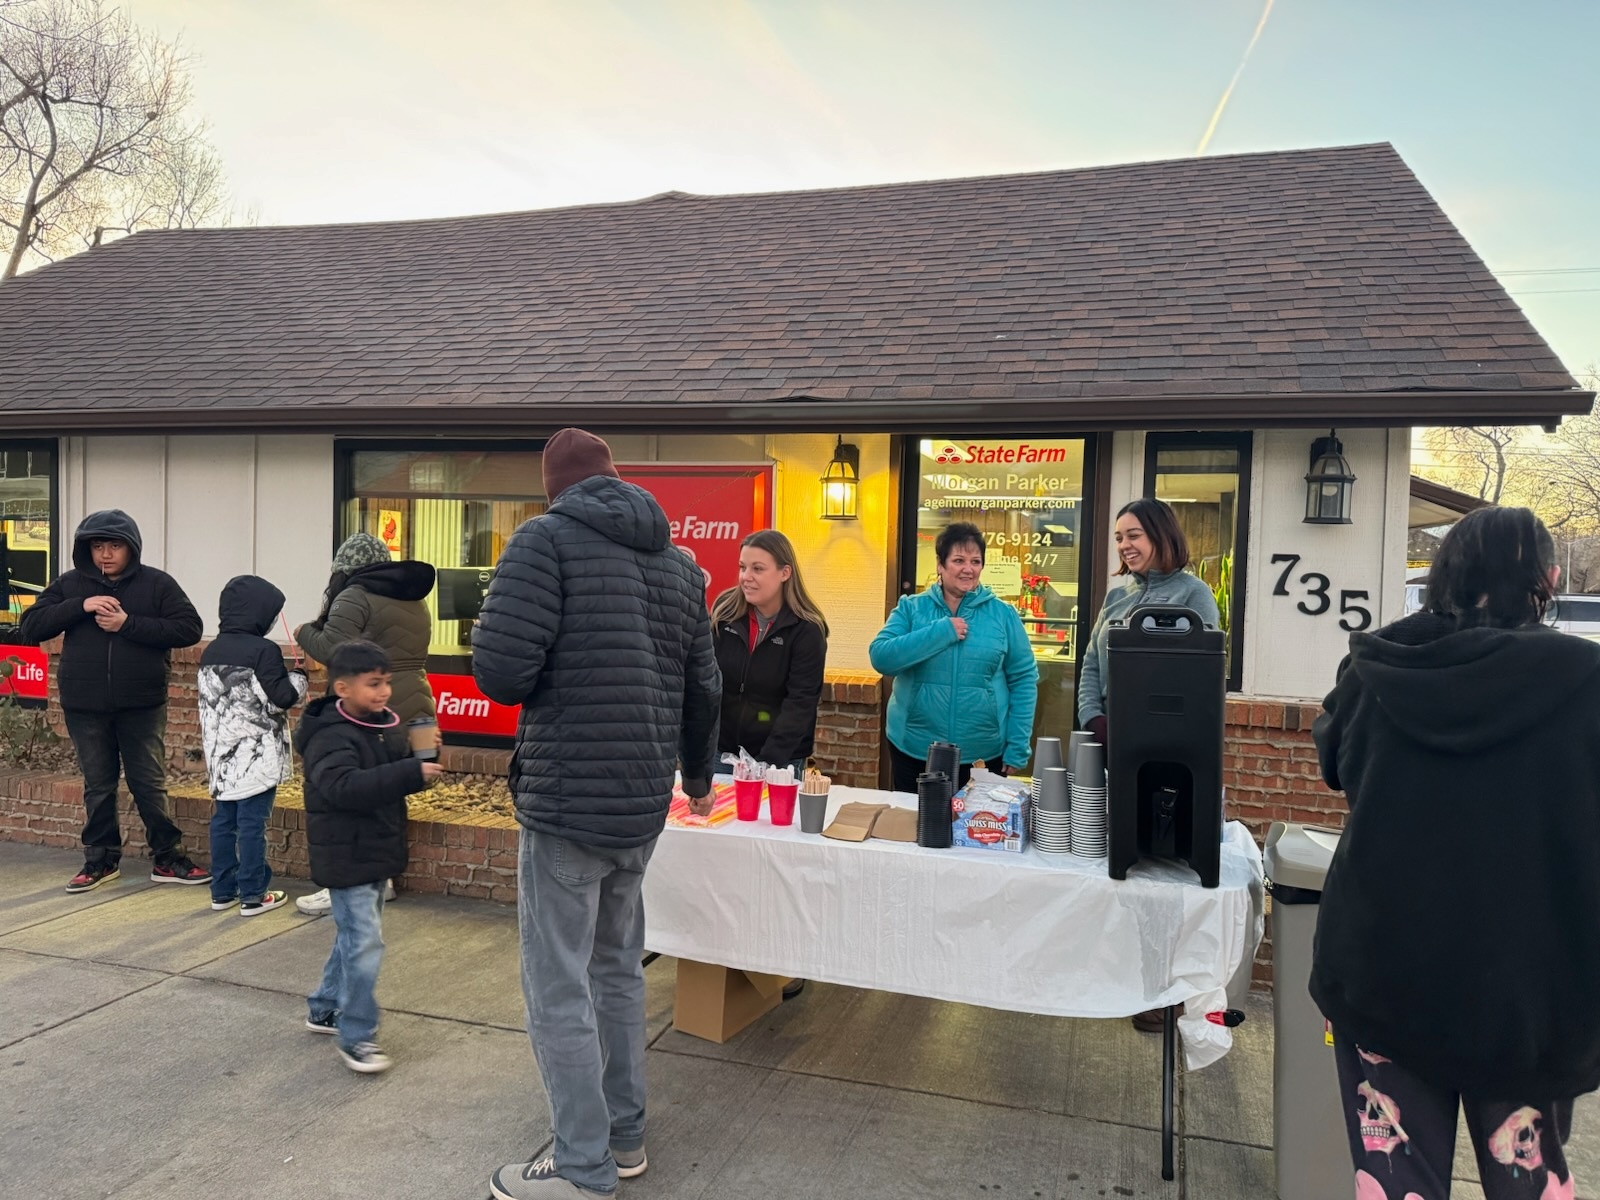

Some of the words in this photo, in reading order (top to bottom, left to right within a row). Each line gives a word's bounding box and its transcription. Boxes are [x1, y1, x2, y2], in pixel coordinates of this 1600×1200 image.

[931, 474, 999, 493] Morgan
[1006, 473, 1069, 490] Parker
[924, 497, 1076, 511] agentmorganparker.com
[1024, 552, 1058, 568] 24/7
[1270, 553, 1372, 632] 735
[17, 663, 44, 682] Life
[433, 691, 490, 718] Farm
[953, 801, 964, 810] 50
